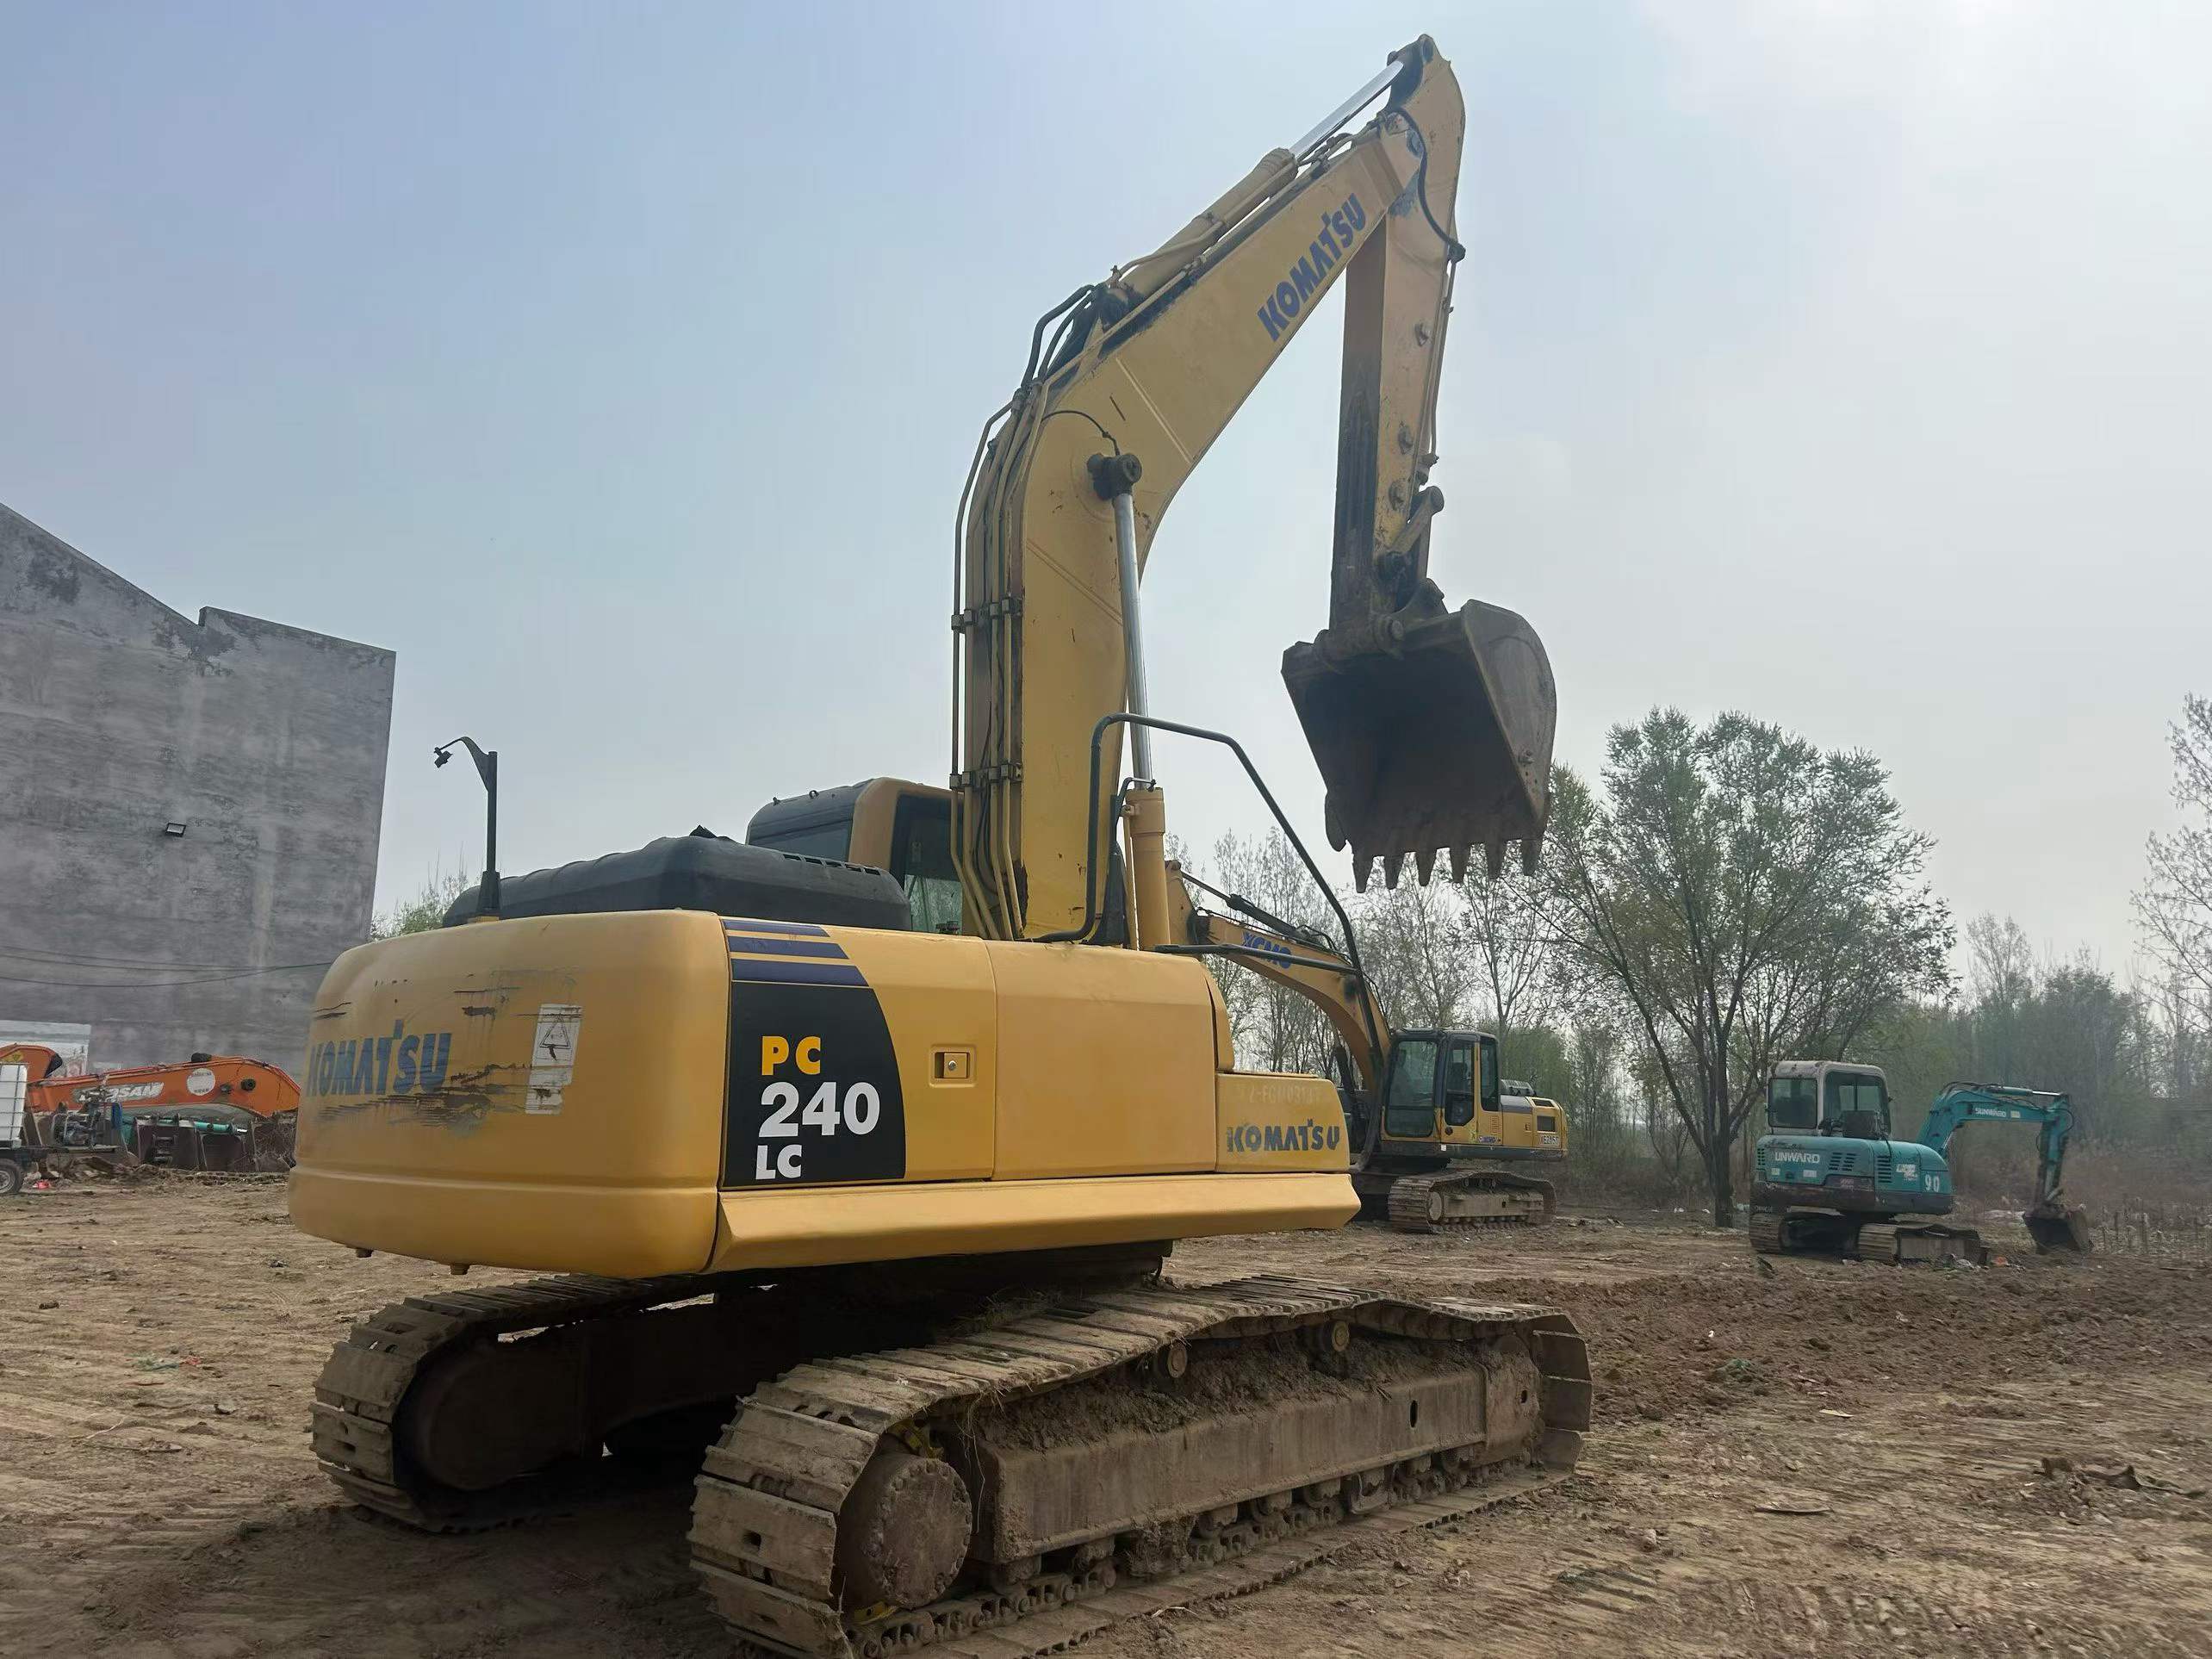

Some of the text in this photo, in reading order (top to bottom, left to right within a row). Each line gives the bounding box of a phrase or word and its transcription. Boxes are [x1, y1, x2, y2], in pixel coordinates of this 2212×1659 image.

[1257, 192, 1366, 342] KOMATSU
[307, 1019, 452, 1096] KOMATSU
[761, 1035, 821, 1076] PC
[758, 1081, 880, 1138] 240
[1226, 1118, 1340, 1153] KOMATSU
[755, 1144, 803, 1180] LC
